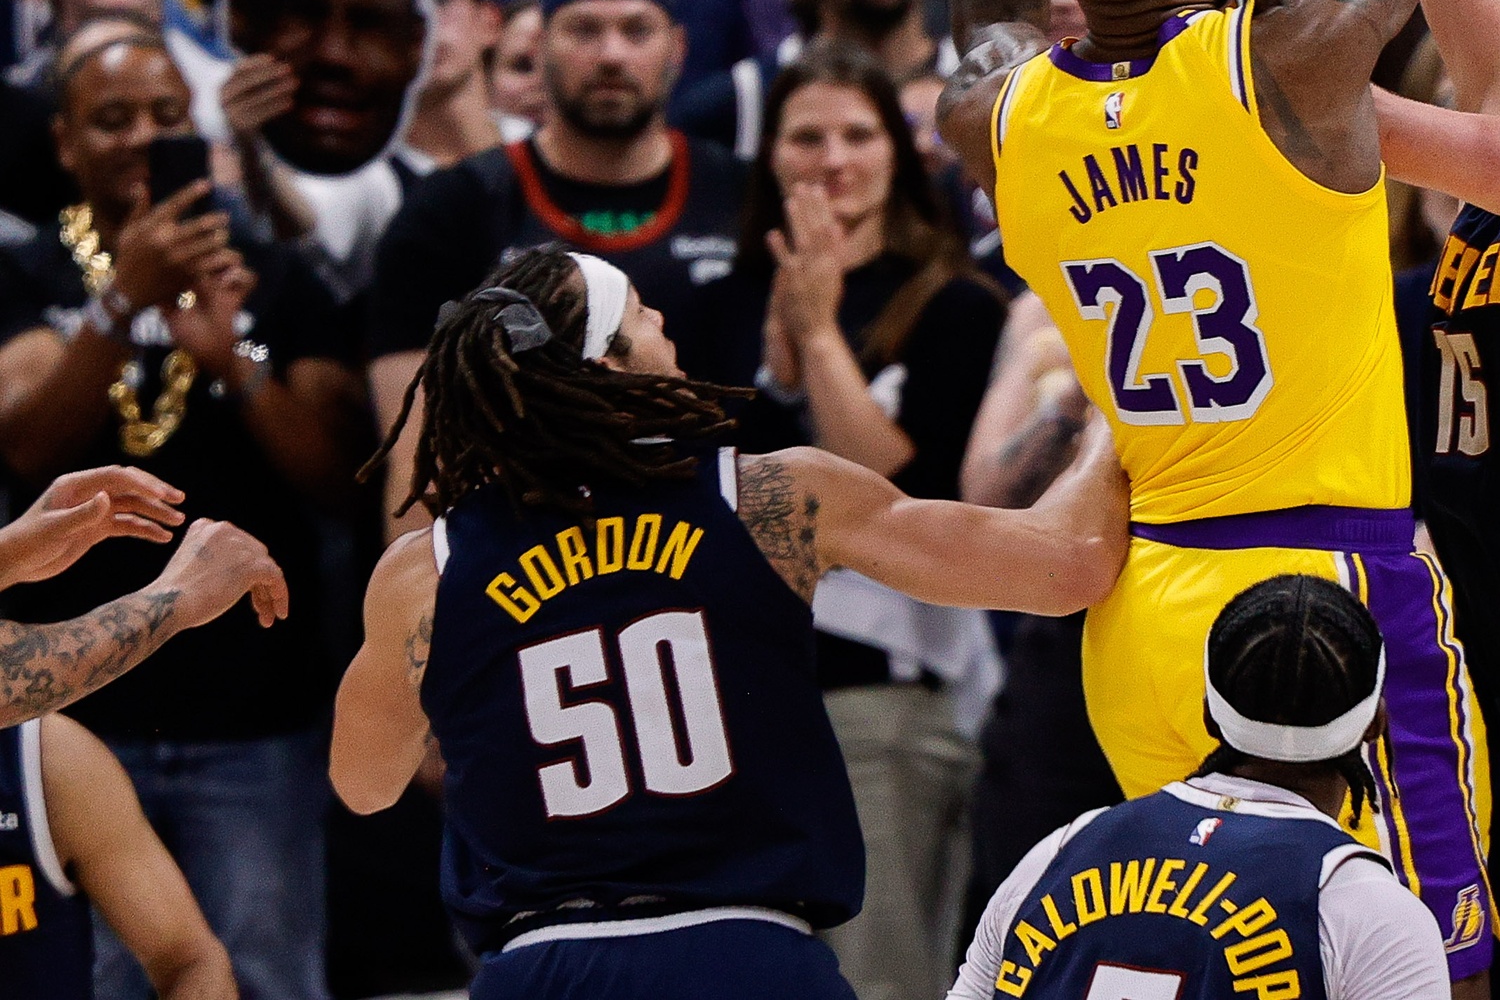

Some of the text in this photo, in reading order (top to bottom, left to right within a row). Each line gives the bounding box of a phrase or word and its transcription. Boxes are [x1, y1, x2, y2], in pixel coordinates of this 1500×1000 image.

[1058, 143, 1198, 224] JAMES
[1059, 240, 1274, 426] 23
[1433, 330, 1489, 456] 15
[486, 513, 704, 624] GORDON
[518, 608, 735, 821] 50
[994, 857, 1301, 1000] CALDWELL-POP
